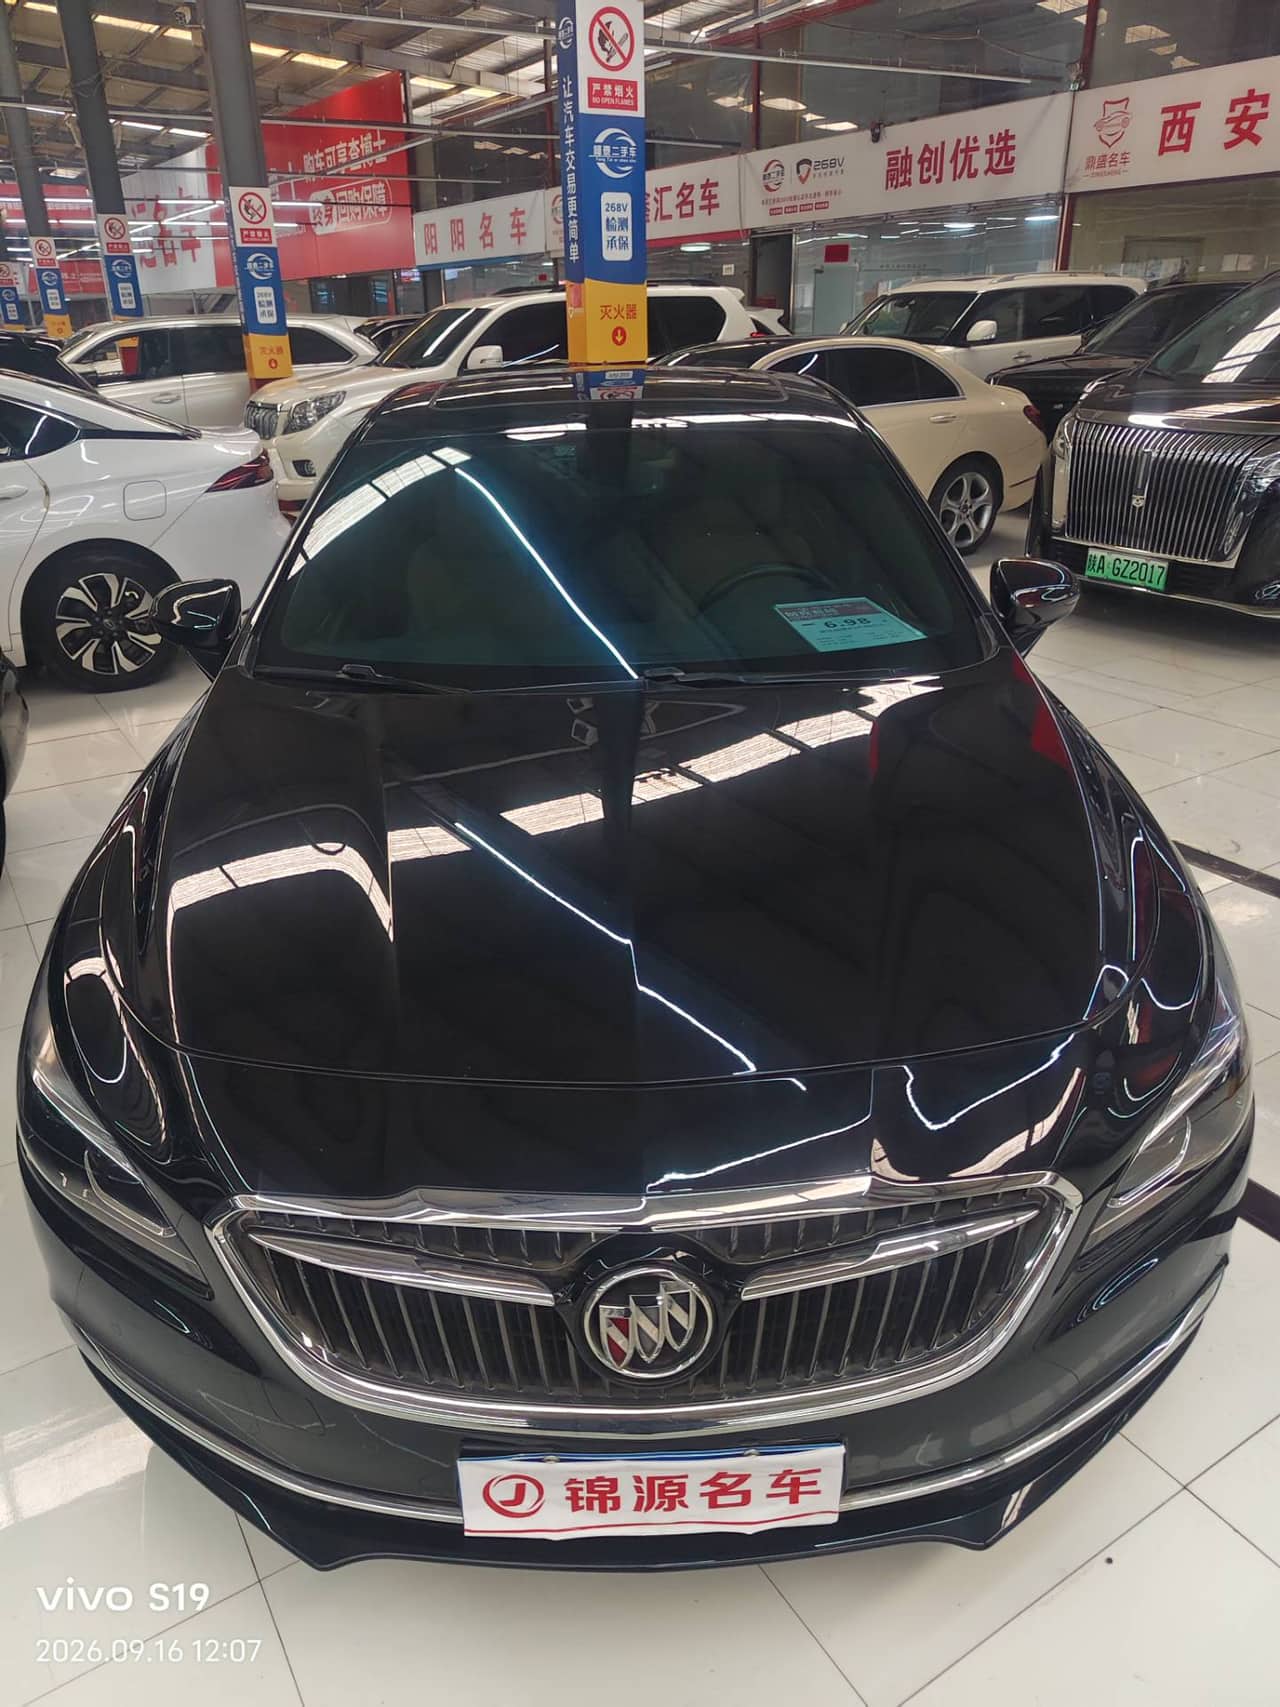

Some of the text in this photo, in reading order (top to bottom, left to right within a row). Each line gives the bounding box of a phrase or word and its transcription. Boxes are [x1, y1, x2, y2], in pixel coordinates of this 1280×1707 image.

[591, 83, 634, 98] 严禁烟火
[1158, 87, 1272, 157] 西安
[813, 156, 845, 171] 268V
[885, 128, 1017, 191] 融创优选
[562, 75, 580, 263] 让汽车交易更简单
[604, 202, 628, 213] 268V
[424, 207, 527, 256] 阳阳名车
[605, 216, 629, 233] 检测
[606, 235, 630, 251] 承保
[600, 304, 638, 320] 灭火器
[1112, 558, 1166, 586] GZ2017
[823, 617, 872, 629] 6.98
[564, 1468, 822, 1514] 锦源名车
